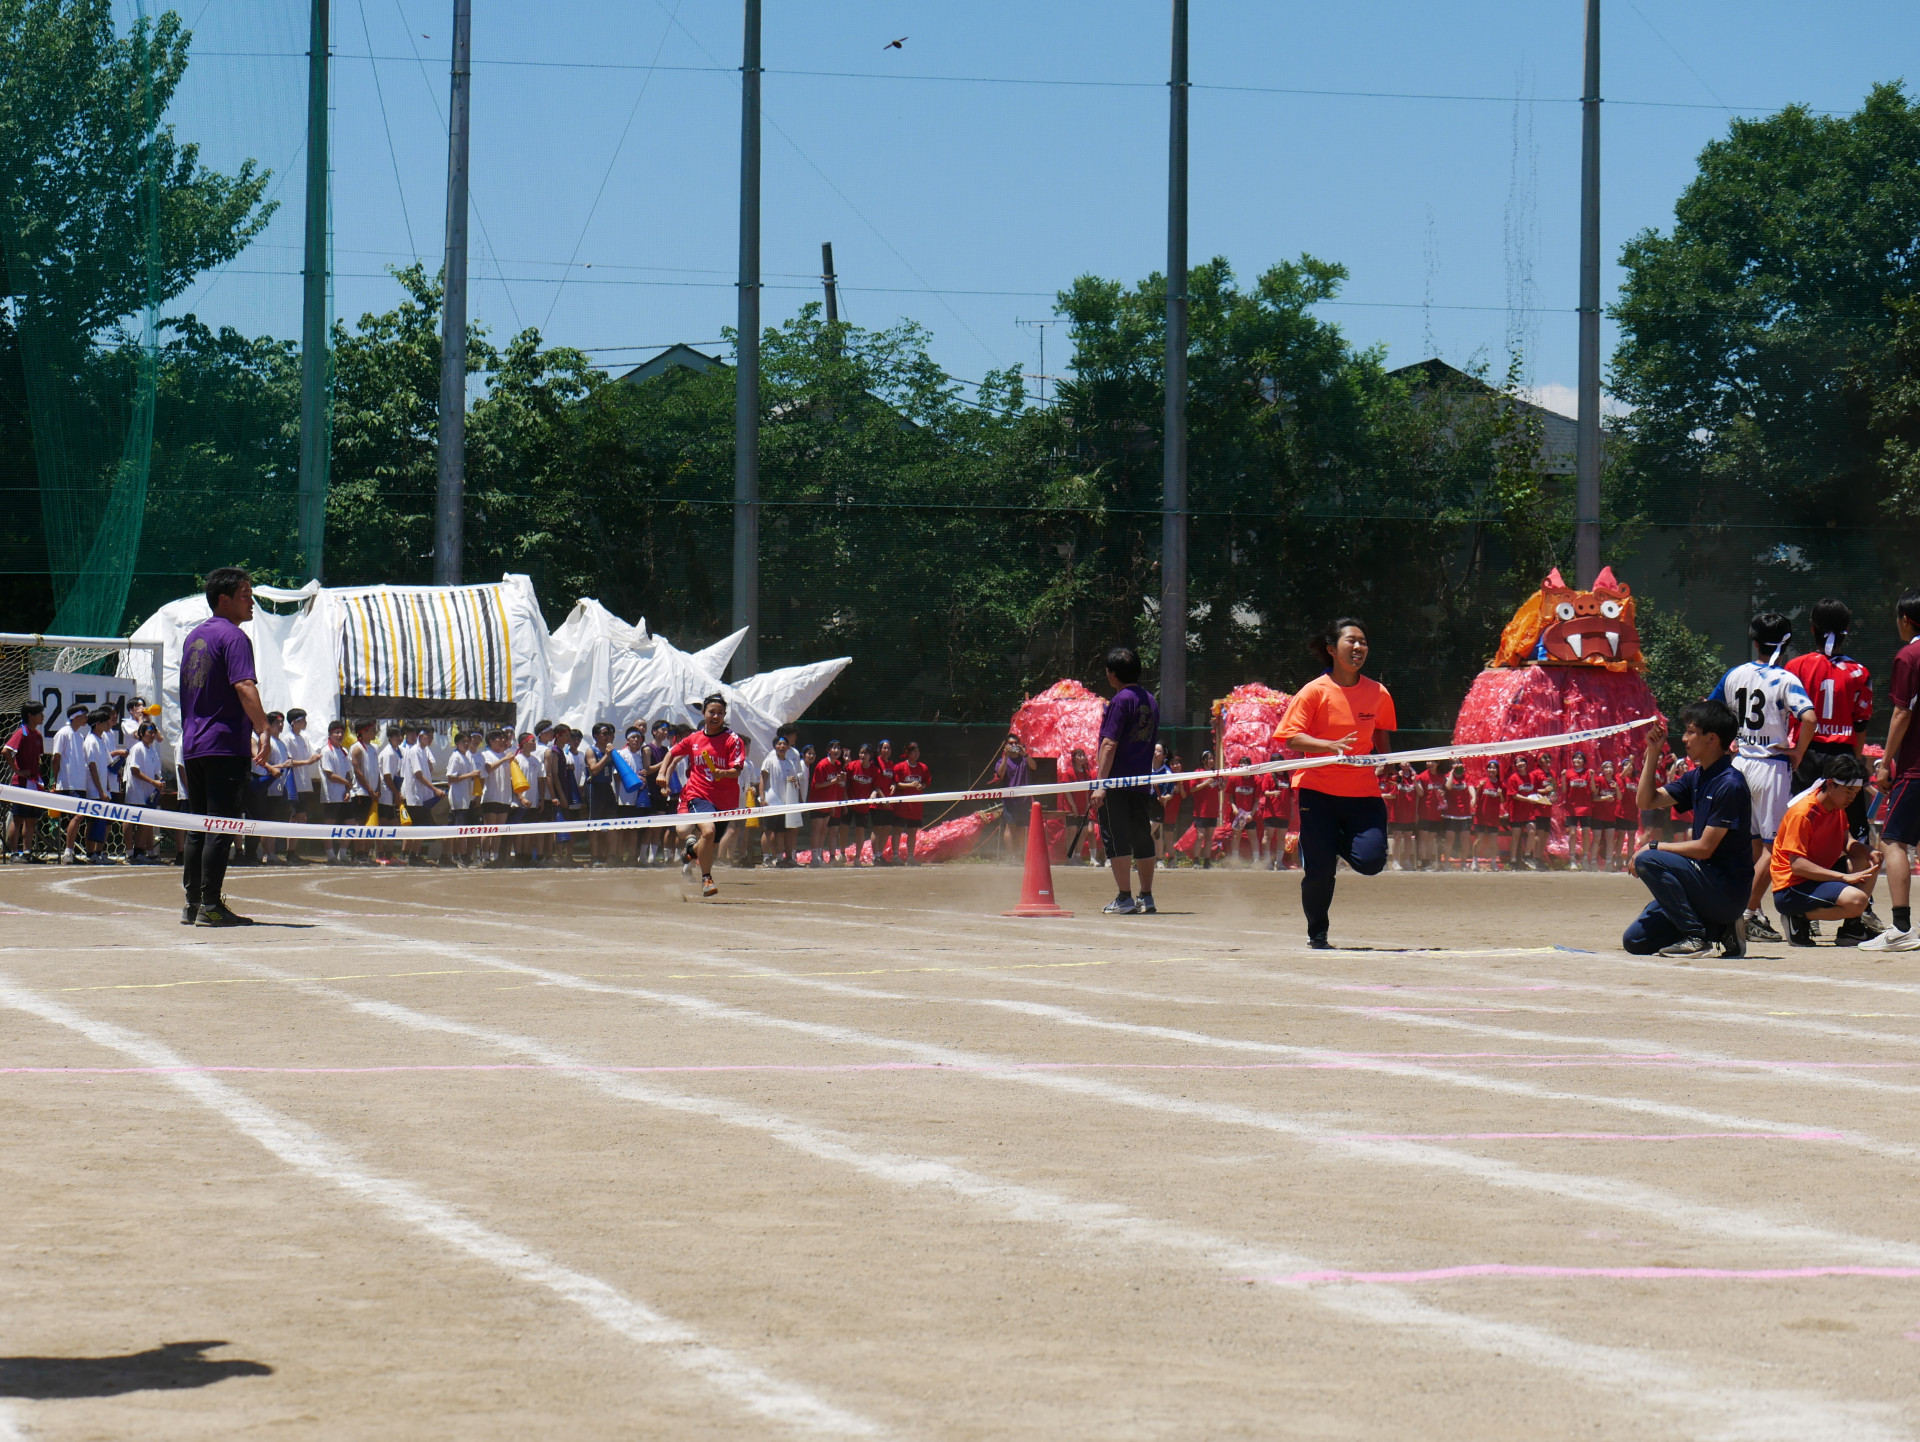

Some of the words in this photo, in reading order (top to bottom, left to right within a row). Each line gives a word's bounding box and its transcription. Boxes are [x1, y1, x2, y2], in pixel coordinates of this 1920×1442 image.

[1735, 688, 1765, 730] 13
[1820, 679, 1834, 719] 1
[1814, 723, 1852, 736] AKUJII
[76, 800, 143, 822] FINISH
[203, 818, 256, 834] Finish
